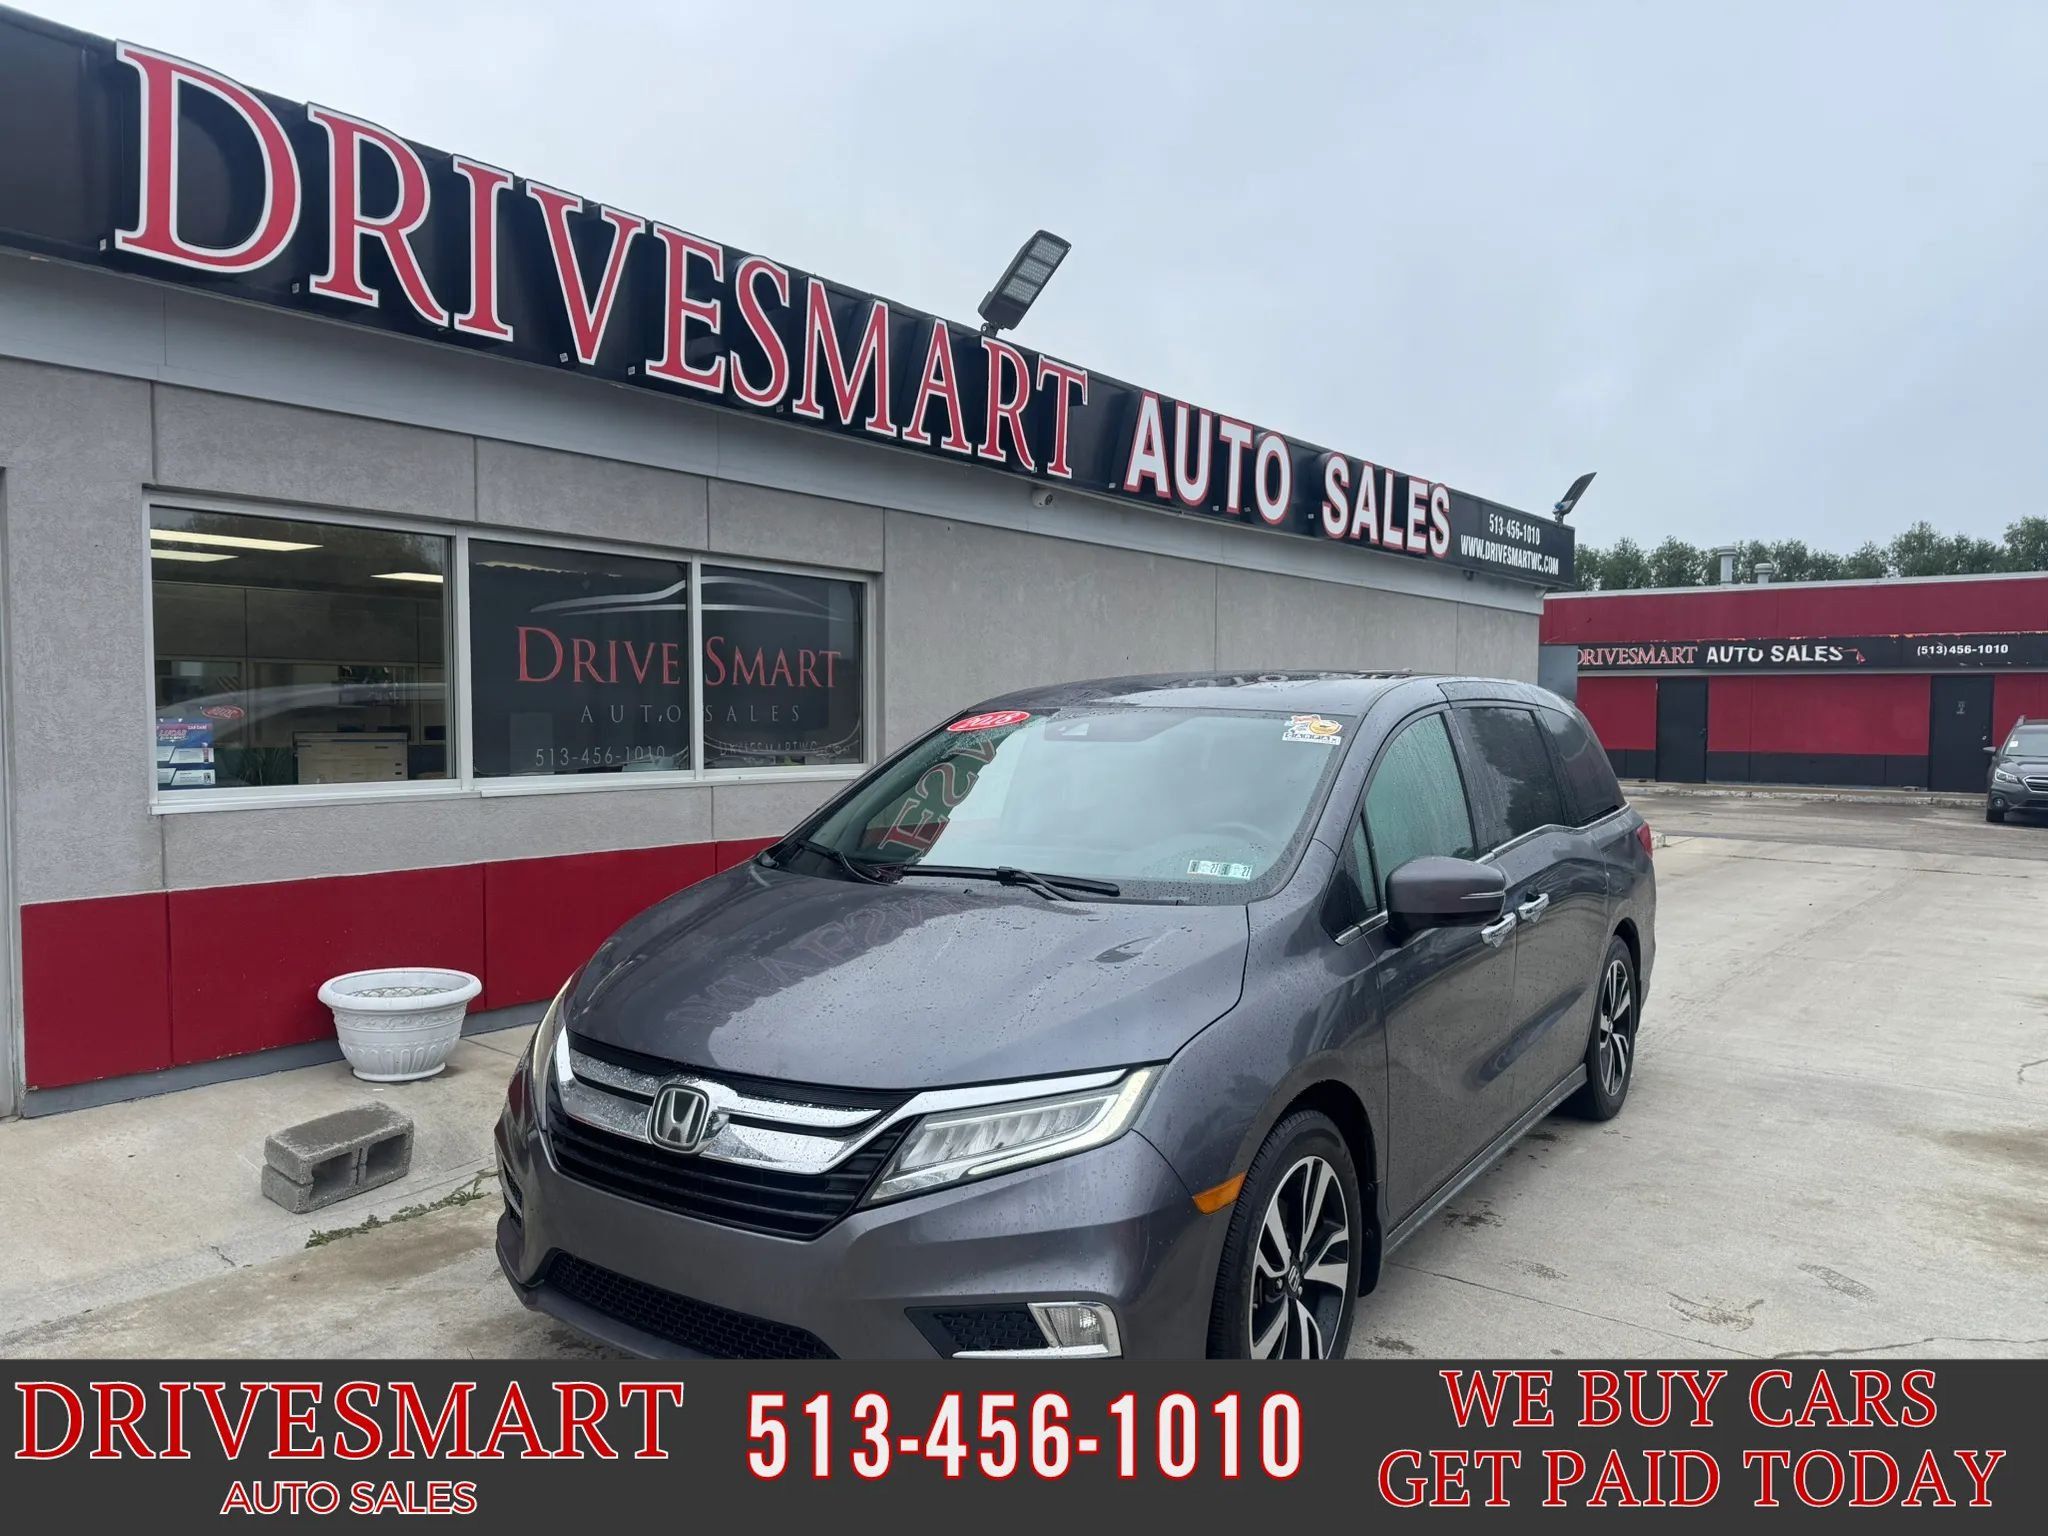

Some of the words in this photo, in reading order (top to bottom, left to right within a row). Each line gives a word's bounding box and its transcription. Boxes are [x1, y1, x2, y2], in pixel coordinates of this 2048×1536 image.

[115, 39, 1089, 480] DRIVESMART
[1123, 391, 1293, 525] AUTO
[1321, 452, 1451, 559] SALES
[1489, 513, 1540, 546] 513-456-1010
[1460, 534, 1559, 575] WWW.DRIVESMARTWC.COM
[515, 625, 681, 685] DRIVE
[705, 636, 842, 688] SMART
[1705, 645, 1764, 664] AUTO
[1770, 644, 1844, 663] SALES
[580, 704, 682, 723] AUTO
[705, 704, 800, 722] SALES
